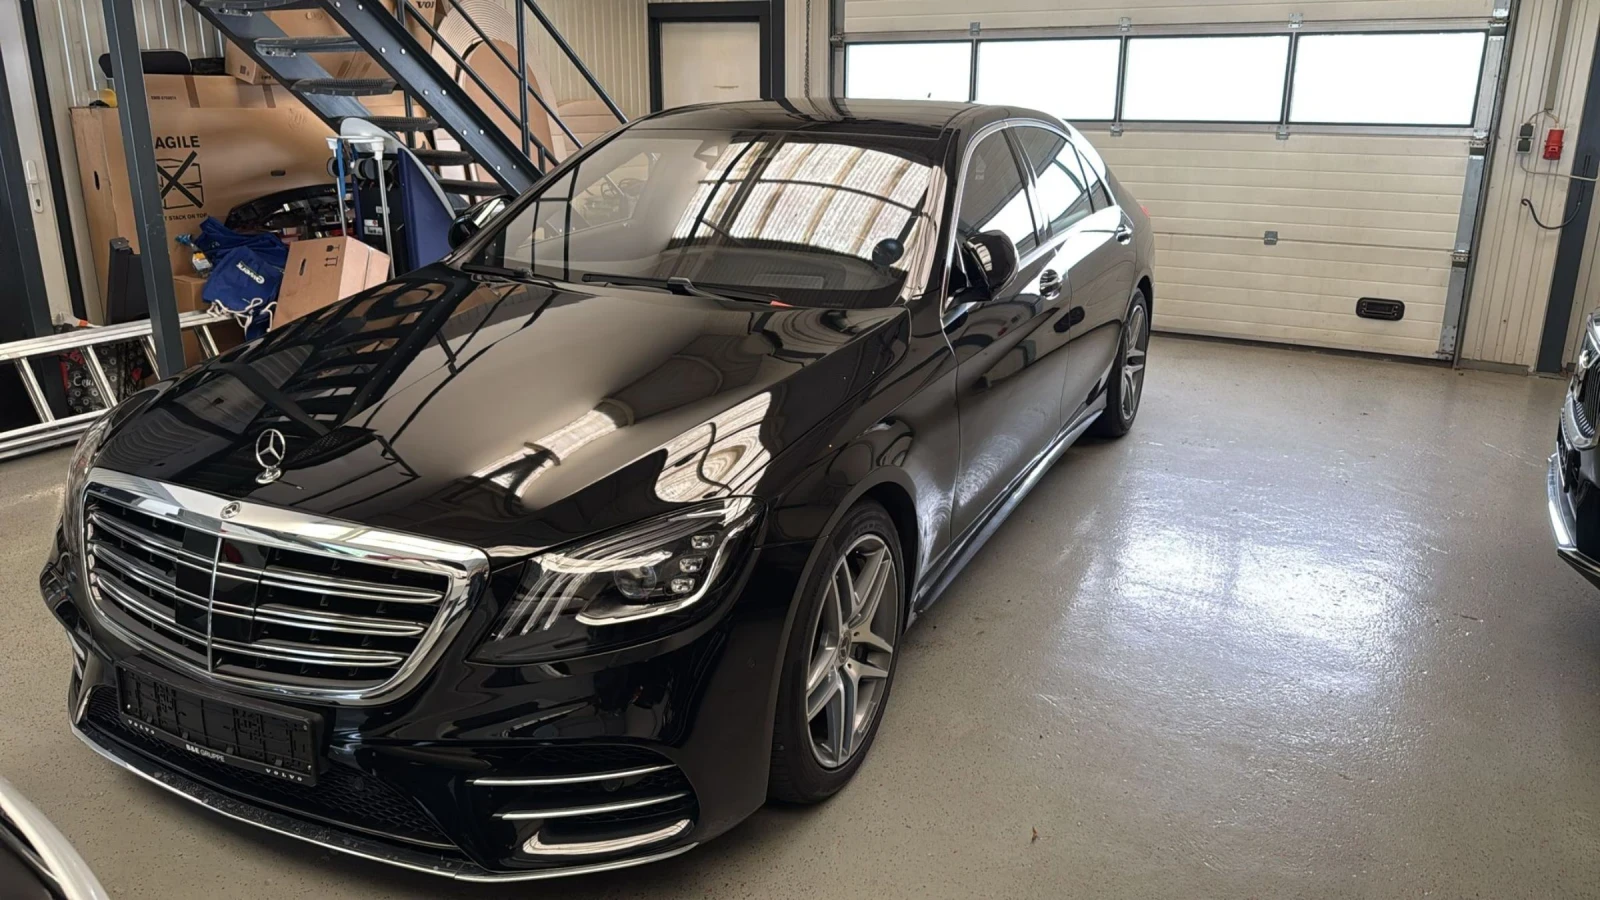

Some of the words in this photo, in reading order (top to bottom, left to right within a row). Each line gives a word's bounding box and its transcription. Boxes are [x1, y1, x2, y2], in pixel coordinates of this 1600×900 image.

[155, 135, 200, 149] AGILE
[128, 719, 155, 735] VOLVO
[200, 749, 225, 763] GRUPPE
[265, 768, 303, 782] VOLVO
